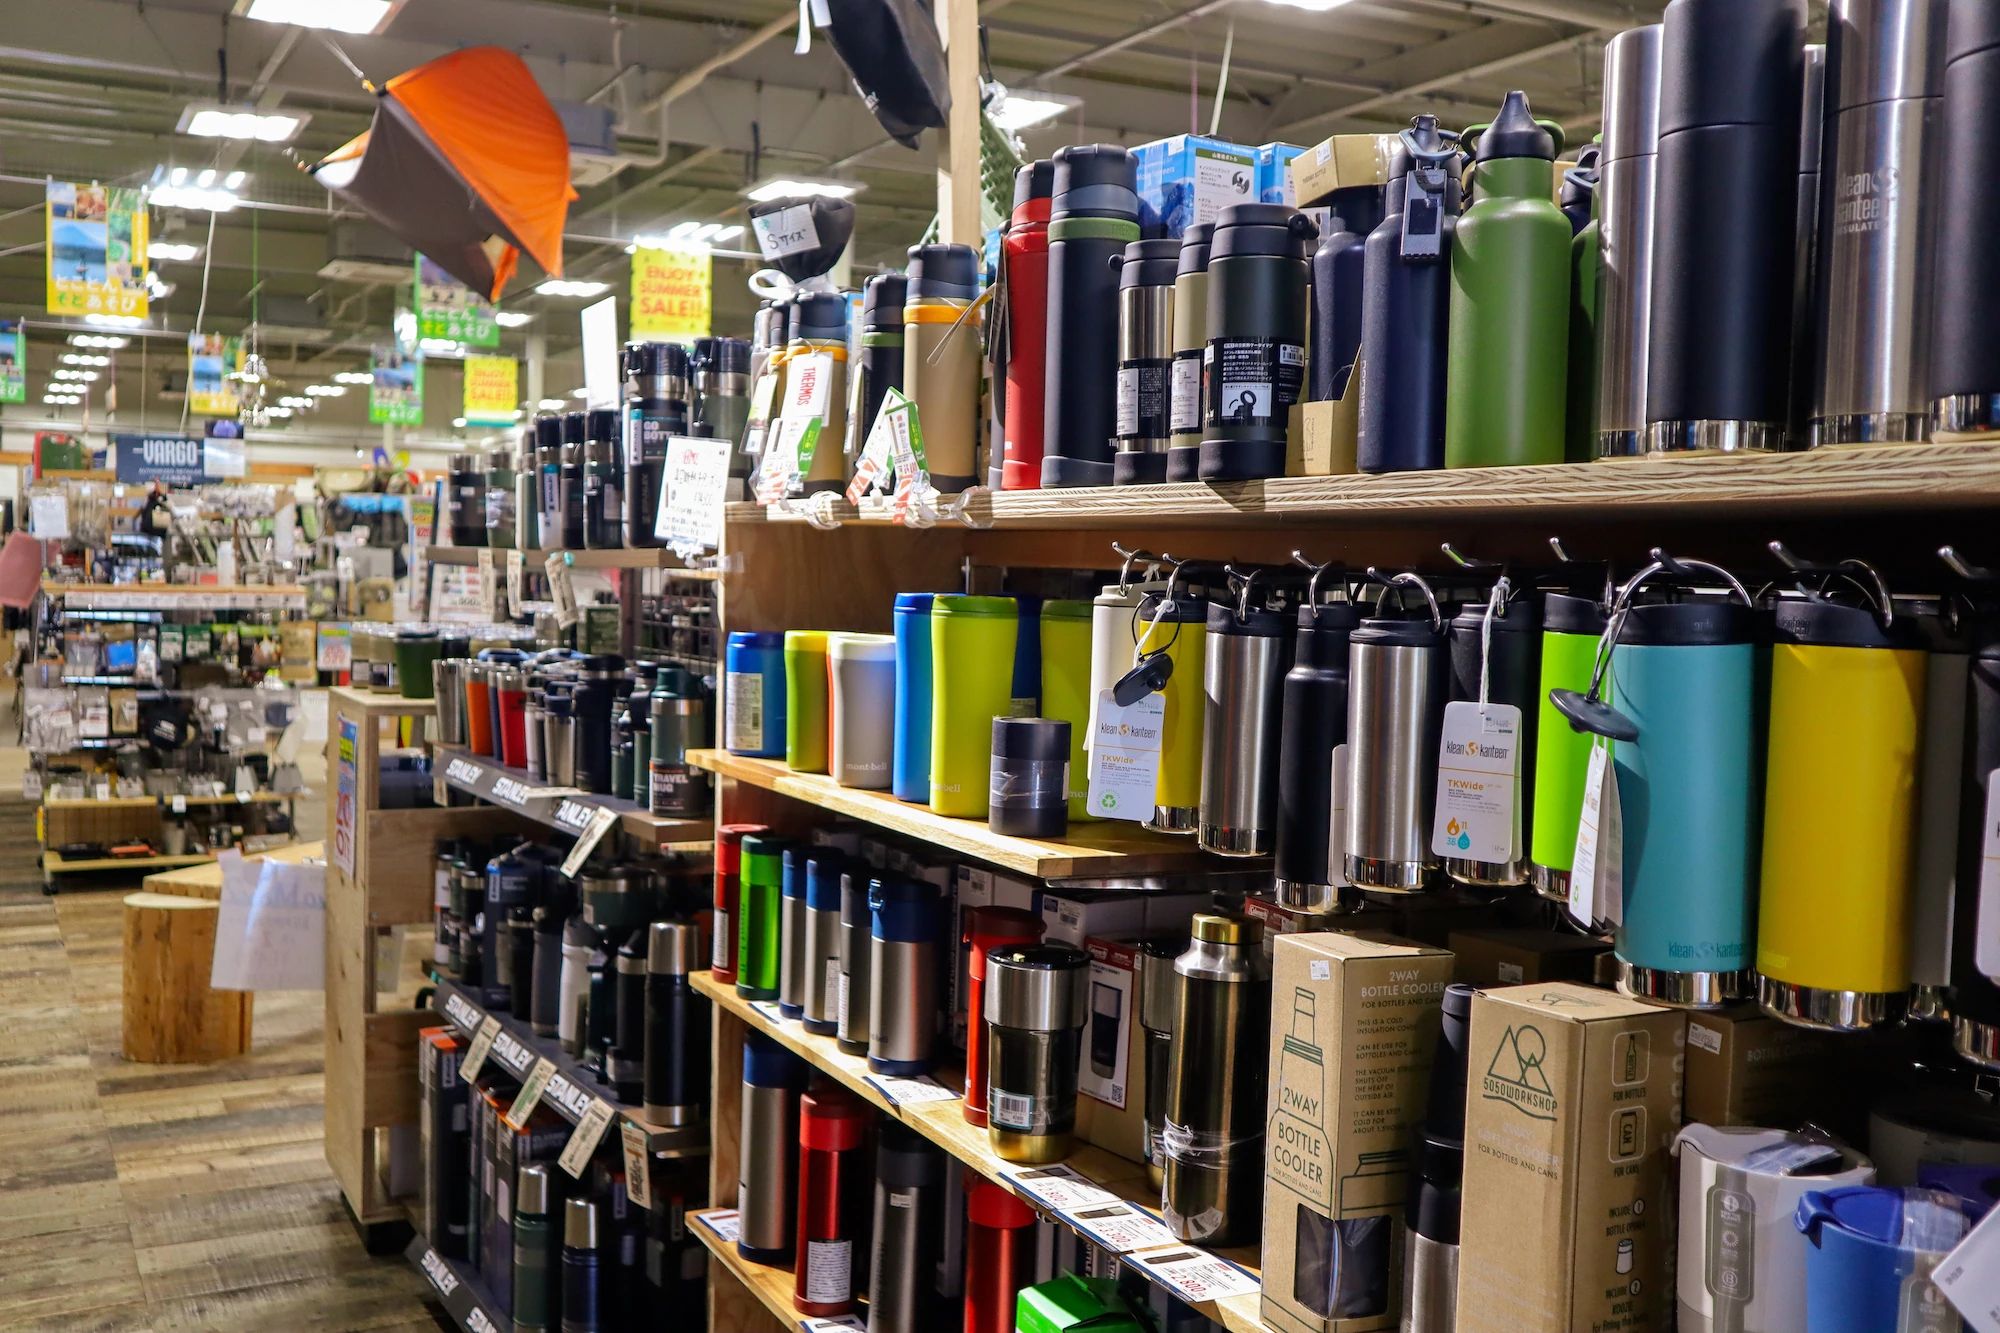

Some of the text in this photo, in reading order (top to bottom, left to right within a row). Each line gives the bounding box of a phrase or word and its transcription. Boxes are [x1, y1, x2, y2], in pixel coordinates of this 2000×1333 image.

[1841, 173, 1870, 196] lean
[646, 265, 694, 280] ENJOY
[640, 280, 702, 298] SUMMER
[797, 367, 817, 406] THERMOS
[143, 439, 198, 466] VARGO
[1101, 722, 1157, 740] klean kanteen
[1101, 754, 1135, 764] TKWide
[1446, 739, 1509, 760] klean kanteen
[445, 758, 484, 786] STANLEY
[846, 762, 887, 771] mont-bell
[654, 773, 690, 784] TRAVEL
[1447, 778, 1485, 791] TKWide
[1668, 941, 1694, 959] klean
[1389, 969, 1420, 982] 2WAY
[1360, 982, 1445, 998] BOTTLE COOLER
[444, 993, 485, 1030] STANLEY
[1361, 1000, 1377, 1009] FOR
[1356, 1025, 1395, 1034] INSULATION
[491, 1032, 537, 1073] STANLEY
[1355, 1068, 1366, 1076] THE
[1355, 1085, 1366, 1093] THE
[1483, 1076, 1558, 1113] 5050WORKSHOP
[1283, 1086, 1319, 1117] 2WAY
[1278, 1121, 1321, 1157] BOTTLE
[1623, 1123, 1634, 1145] CAN
[1273, 1145, 1323, 1185] COOLER
[1520, 1160, 1536, 1173] AND
[1537, 1166, 1559, 1181] CANS
[420, 1249, 460, 1298] STANLEY
